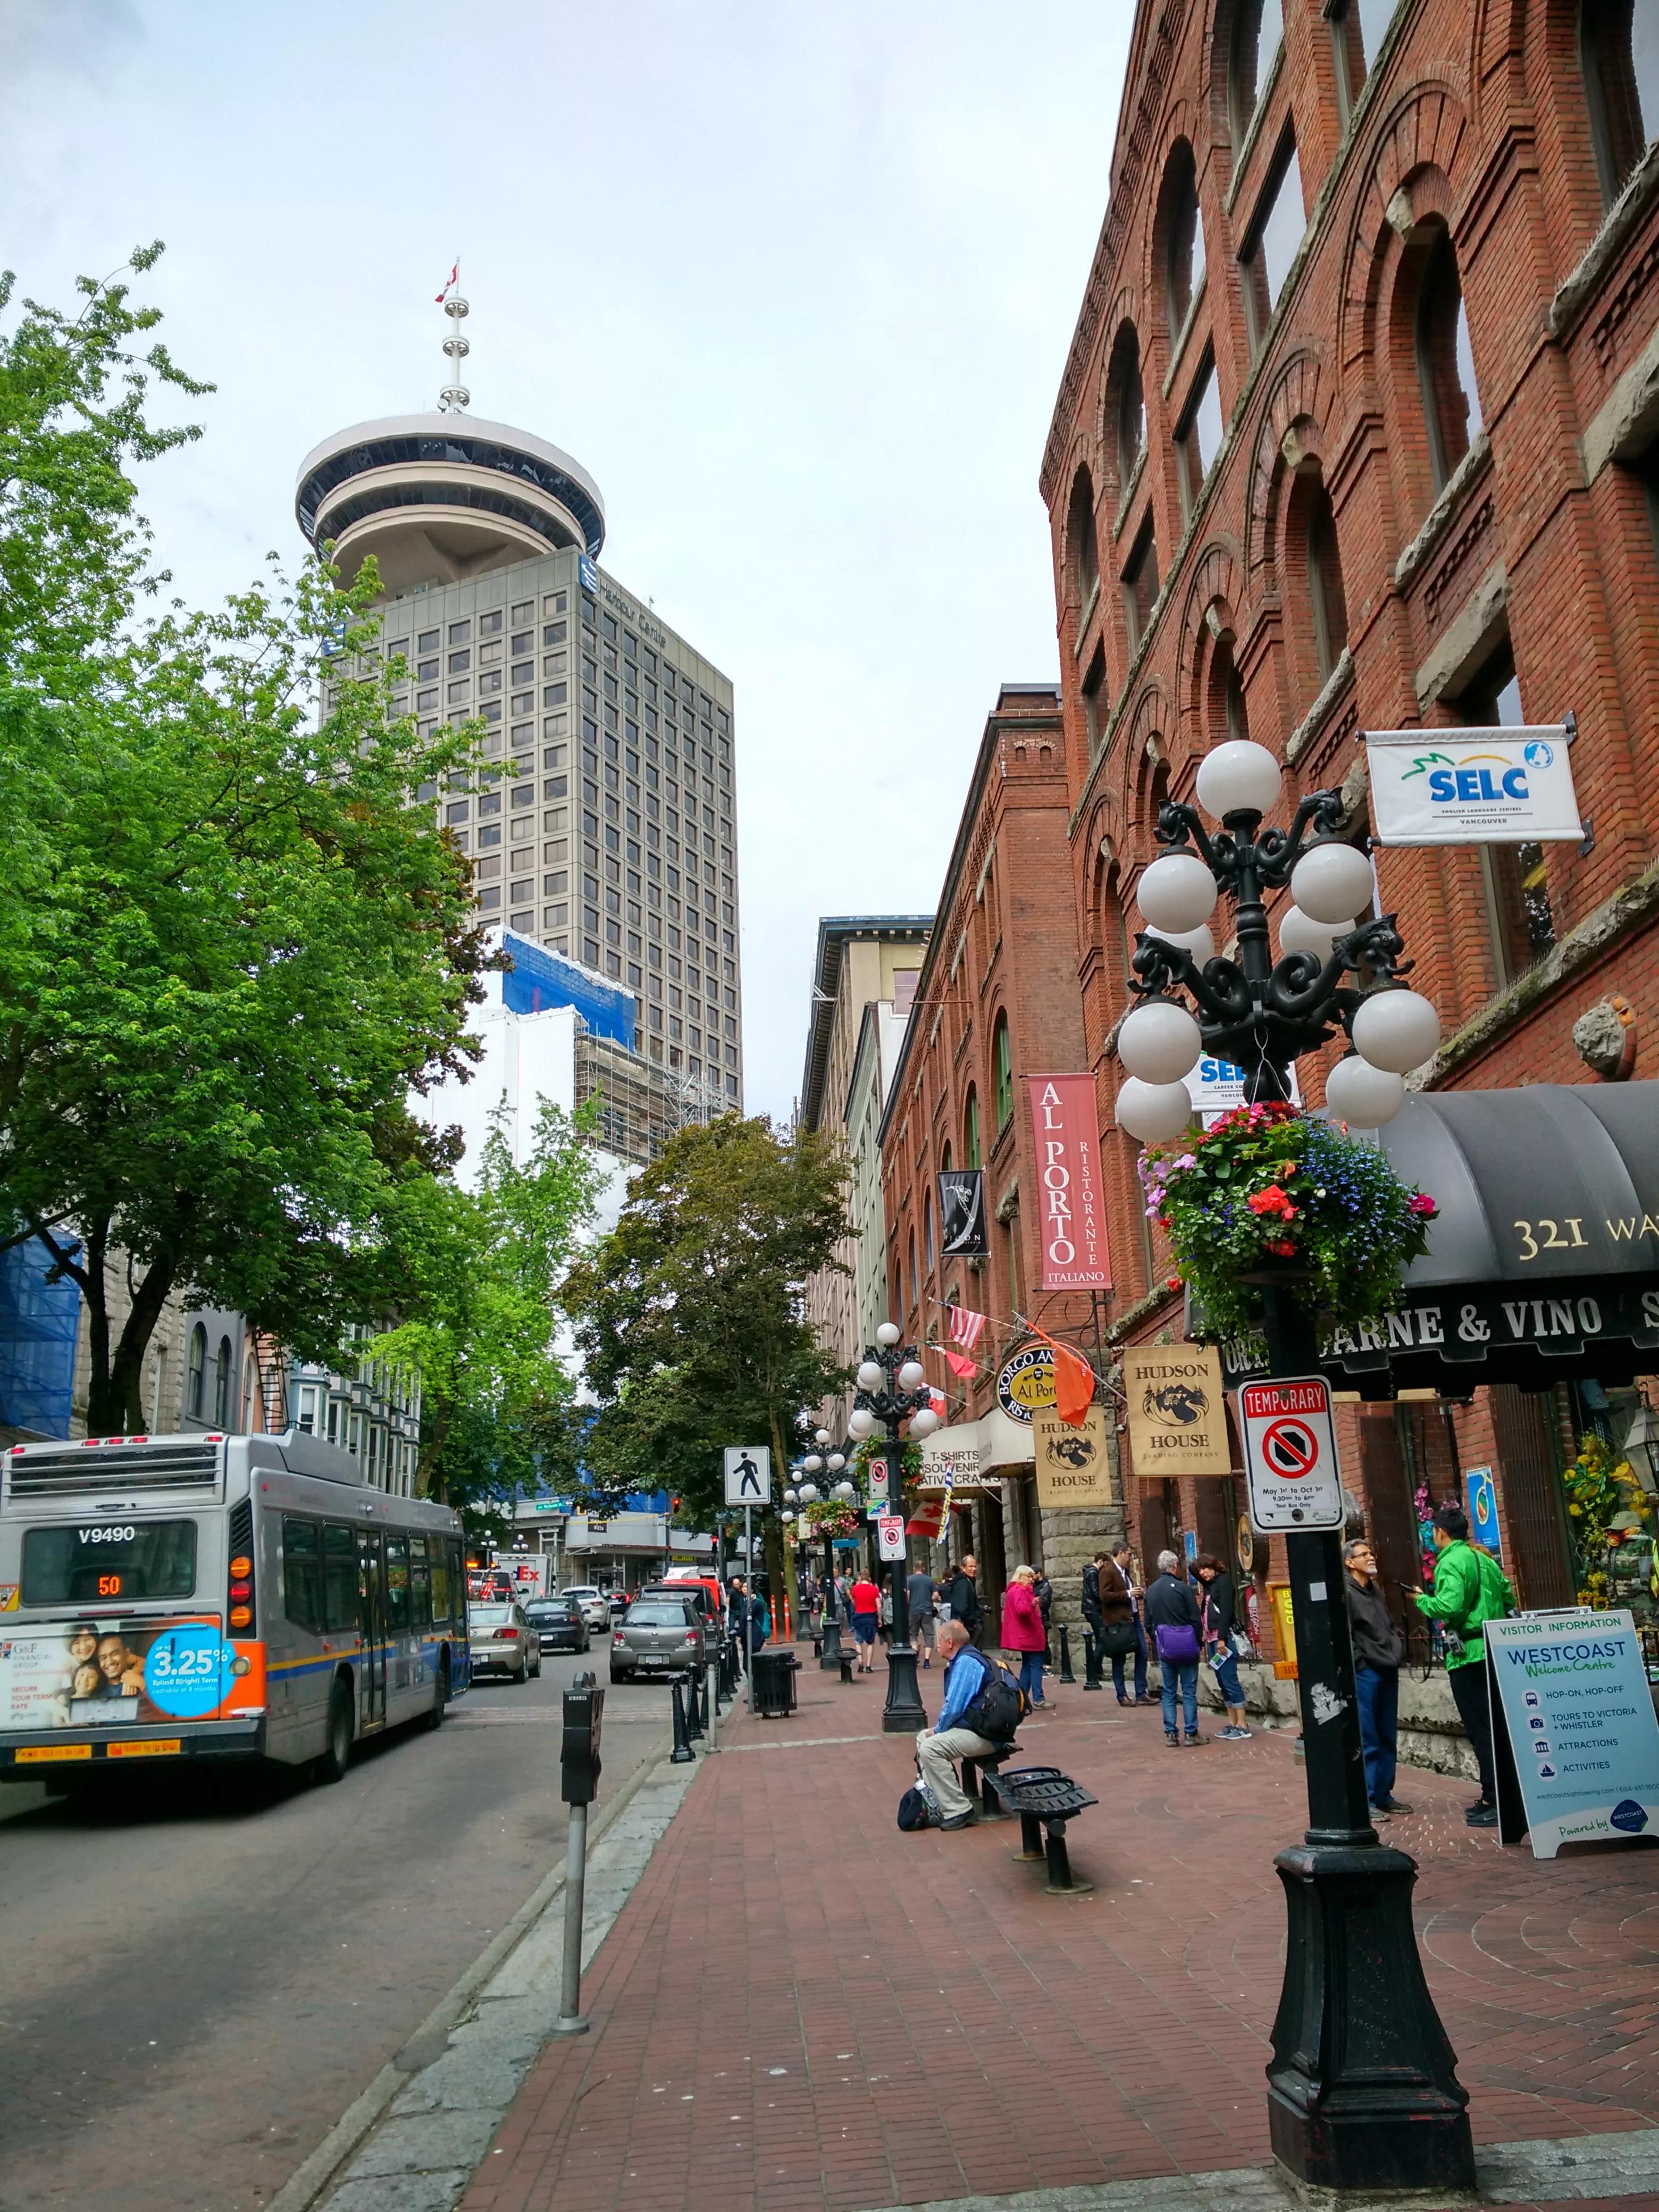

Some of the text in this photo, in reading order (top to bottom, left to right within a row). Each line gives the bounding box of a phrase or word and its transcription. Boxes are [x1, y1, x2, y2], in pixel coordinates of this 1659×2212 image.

[598, 577, 666, 647] Harbour Centre
[1429, 767, 1529, 802] SELC
[1200, 1059, 1246, 1082] SEL
[1039, 1082, 1075, 1265] AL PORTO
[1079, 1141, 1098, 1265] RISTORANTE
[1514, 1214, 1659, 1260] 321 WA
[1048, 1271, 1105, 1283] ITALIANO
[1319, 1291, 1659, 1357] ARNE & VINO S
[1000, 1351, 1054, 1395] BORGO AN
[1135, 1364, 1209, 1379] HUDSON
[1017, 1384, 1032, 1401] Al
[1247, 1387, 1322, 1413] TEMPORARY
[1041, 1421, 1096, 1433] HUDSON
[1150, 1435, 1209, 1448] HOUSE
[931, 1451, 978, 1461] T-SHIRTS
[925, 1462, 979, 1473] SOUVENIR
[1051, 1476, 1096, 1487] HOUSE
[79, 1526, 135, 1544] V9490
[98, 1576, 120, 1595] 50
[1499, 1618, 1621, 1636] VISITOR INFORMATION
[14, 1642, 37, 1654] G&F
[1507, 1641, 1626, 1665] WESTCOAST
[1526, 1658, 1615, 1678] Welcome Centre
[1546, 1685, 1624, 1699] HOP-ON, HOP-OFF
[1551, 1712, 1581, 1722] TOURS
[1596, 1707, 1637, 1718] VICTORIA
[1560, 1720, 1603, 1730] WHISTLER
[1559, 1739, 1619, 1750] ATTRACTIONS
[1563, 1761, 1611, 1772] ACTIVITIES
[1537, 1788, 1614, 1800] westcoastsightseeing.com
[1613, 1810, 1643, 1821] WESTCOAST
[1559, 1821, 1595, 1837] Powered
[1596, 1819, 1609, 1831] by
